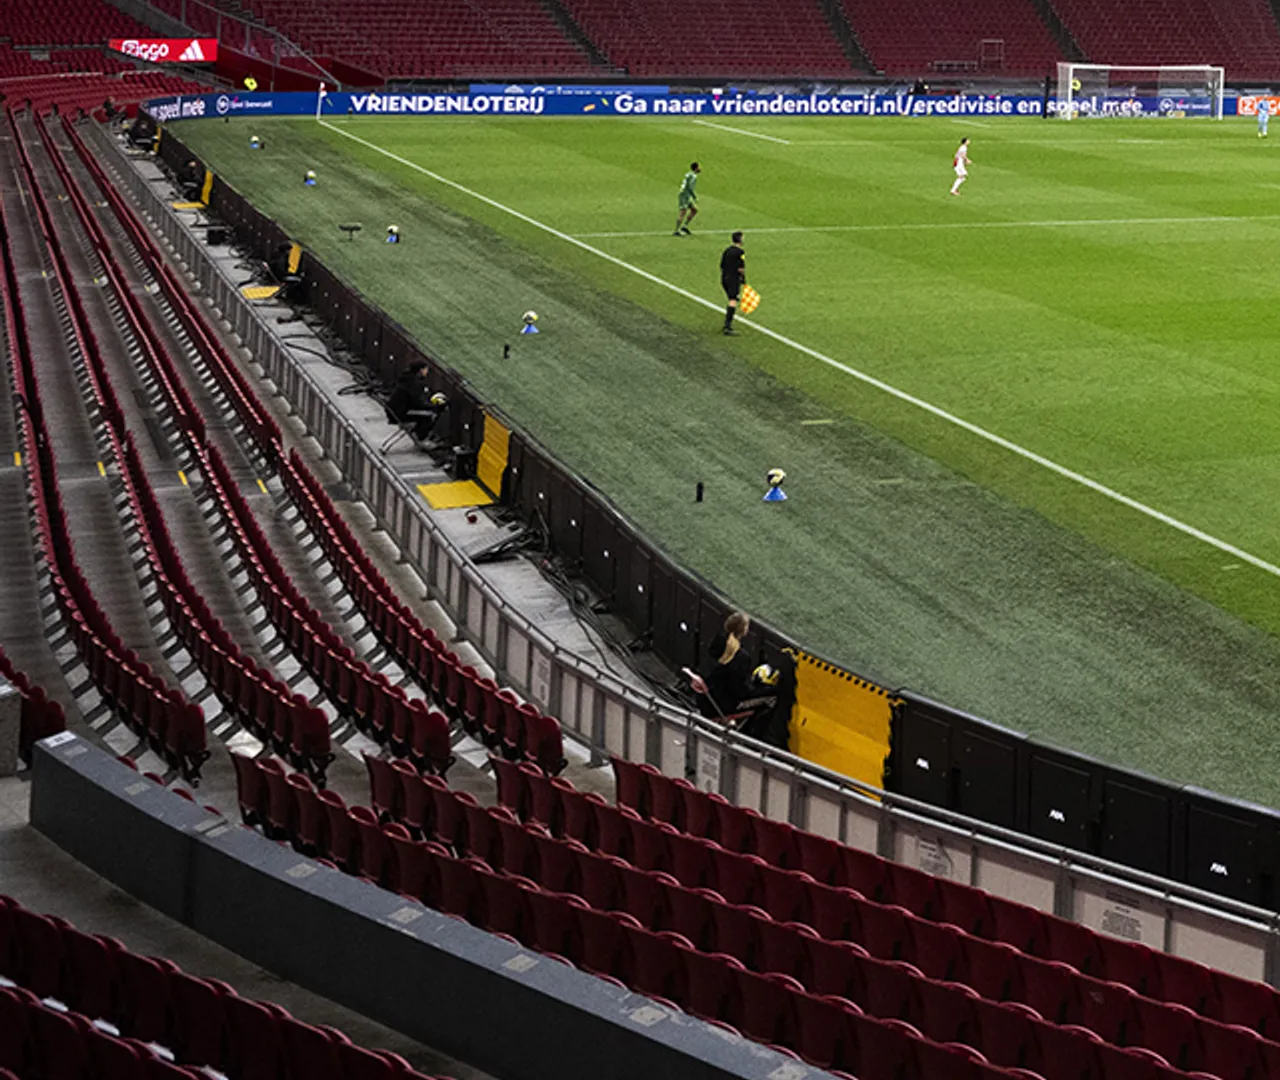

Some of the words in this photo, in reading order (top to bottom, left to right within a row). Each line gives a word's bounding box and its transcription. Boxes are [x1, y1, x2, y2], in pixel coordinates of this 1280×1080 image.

[351, 95, 545, 115] VRIENDENLOTERIJ
[614, 94, 648, 114] Ga
[653, 99, 703, 114] naar
[711, 93, 1013, 117] vriendenloterij.nl/eredivisie
[1017, 99, 1042, 113] en
[1102, 99, 1143, 113] mee
